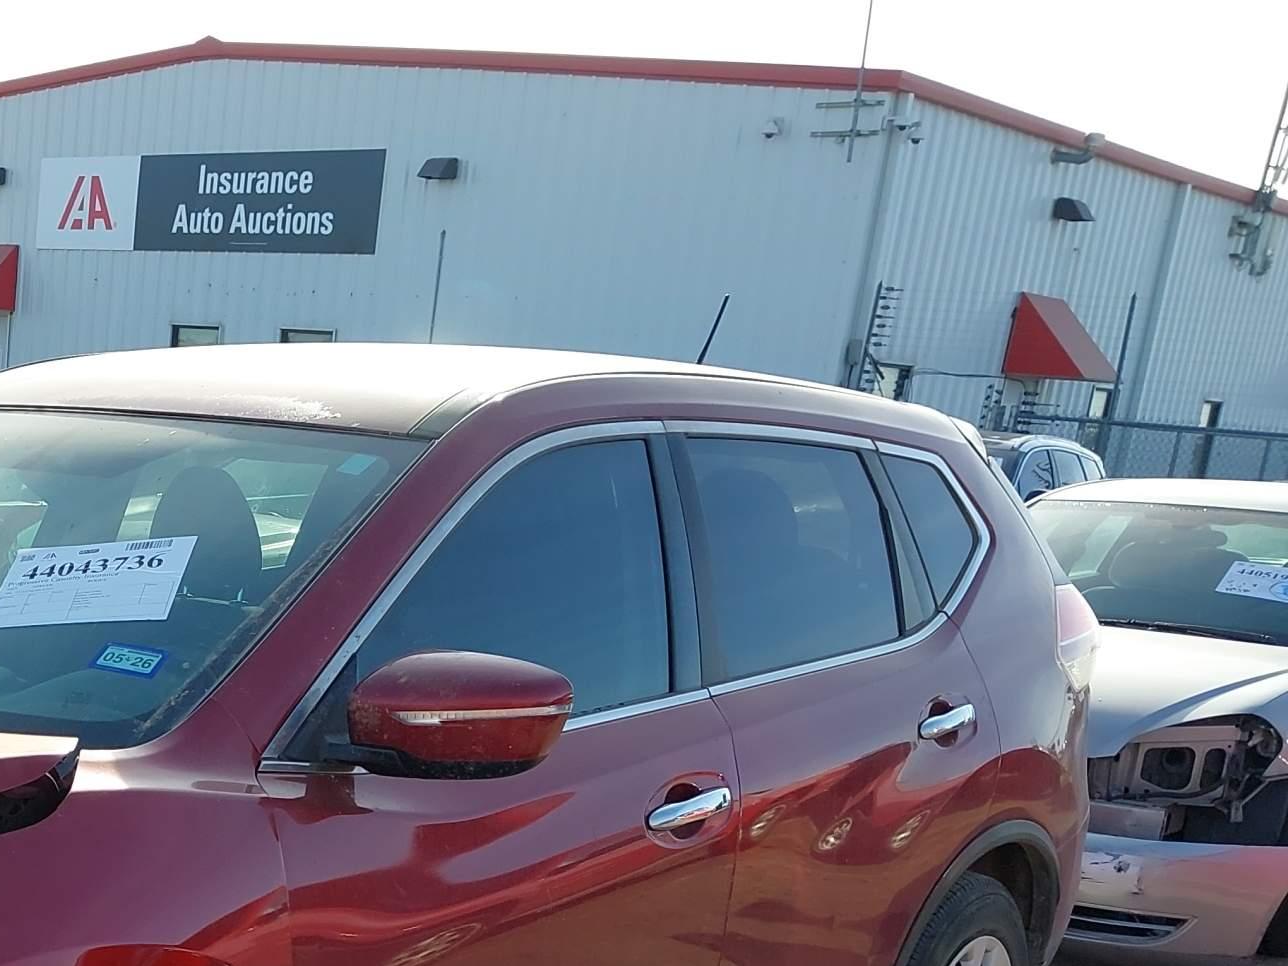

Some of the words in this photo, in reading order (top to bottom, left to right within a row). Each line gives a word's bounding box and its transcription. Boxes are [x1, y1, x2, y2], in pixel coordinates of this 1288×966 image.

[198, 164, 314, 195] Insurance
[171, 204, 224, 235] Auto
[229, 203, 335, 236] Auctions
[21, 552, 166, 580] 44043736
